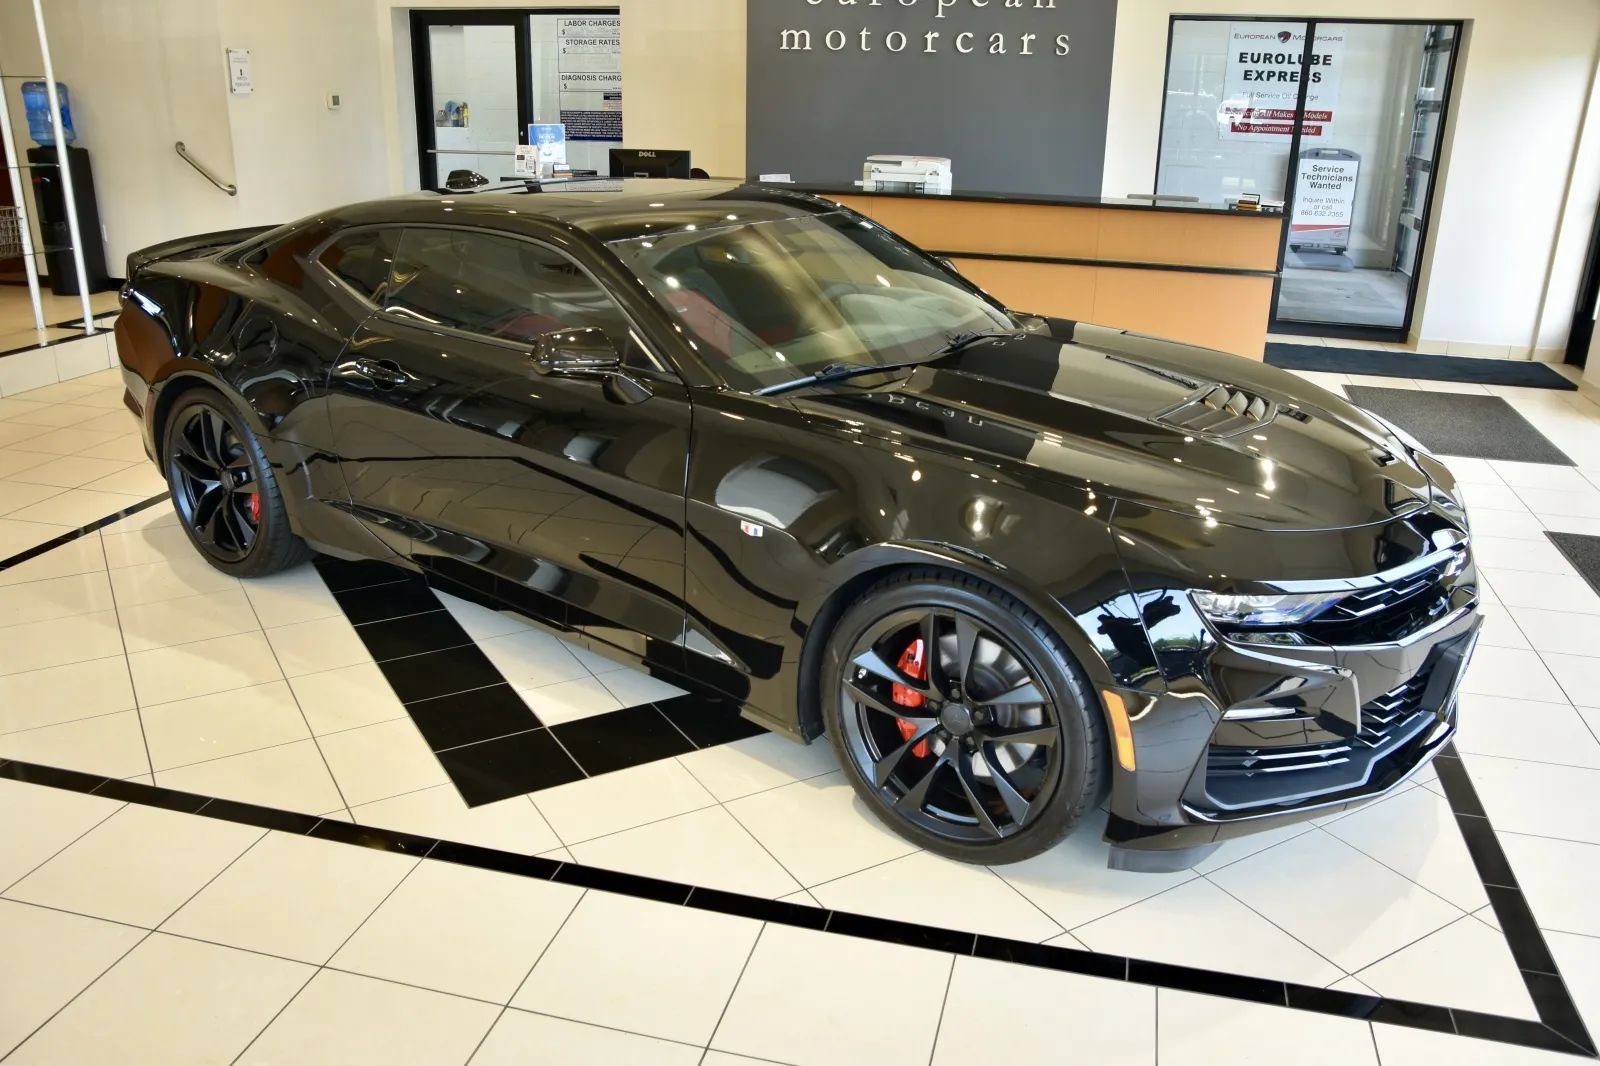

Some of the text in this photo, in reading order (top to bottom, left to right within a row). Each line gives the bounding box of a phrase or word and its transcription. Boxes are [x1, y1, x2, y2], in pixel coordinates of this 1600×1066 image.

[588, 20, 620, 28] CHARGES
[562, 28, 566, 36] $
[780, 26, 1070, 56] motorcars
[562, 47, 567, 55] $
[1243, 69, 1323, 83] EXPRES
[1272, 110, 1294, 118] Makes
[1303, 112, 1328, 120] Models
[1249, 124, 1290, 133] Appointment
[1312, 164, 1345, 174] Service
[1301, 173, 1353, 182] Technicians
[1309, 182, 1342, 190] Wanted
